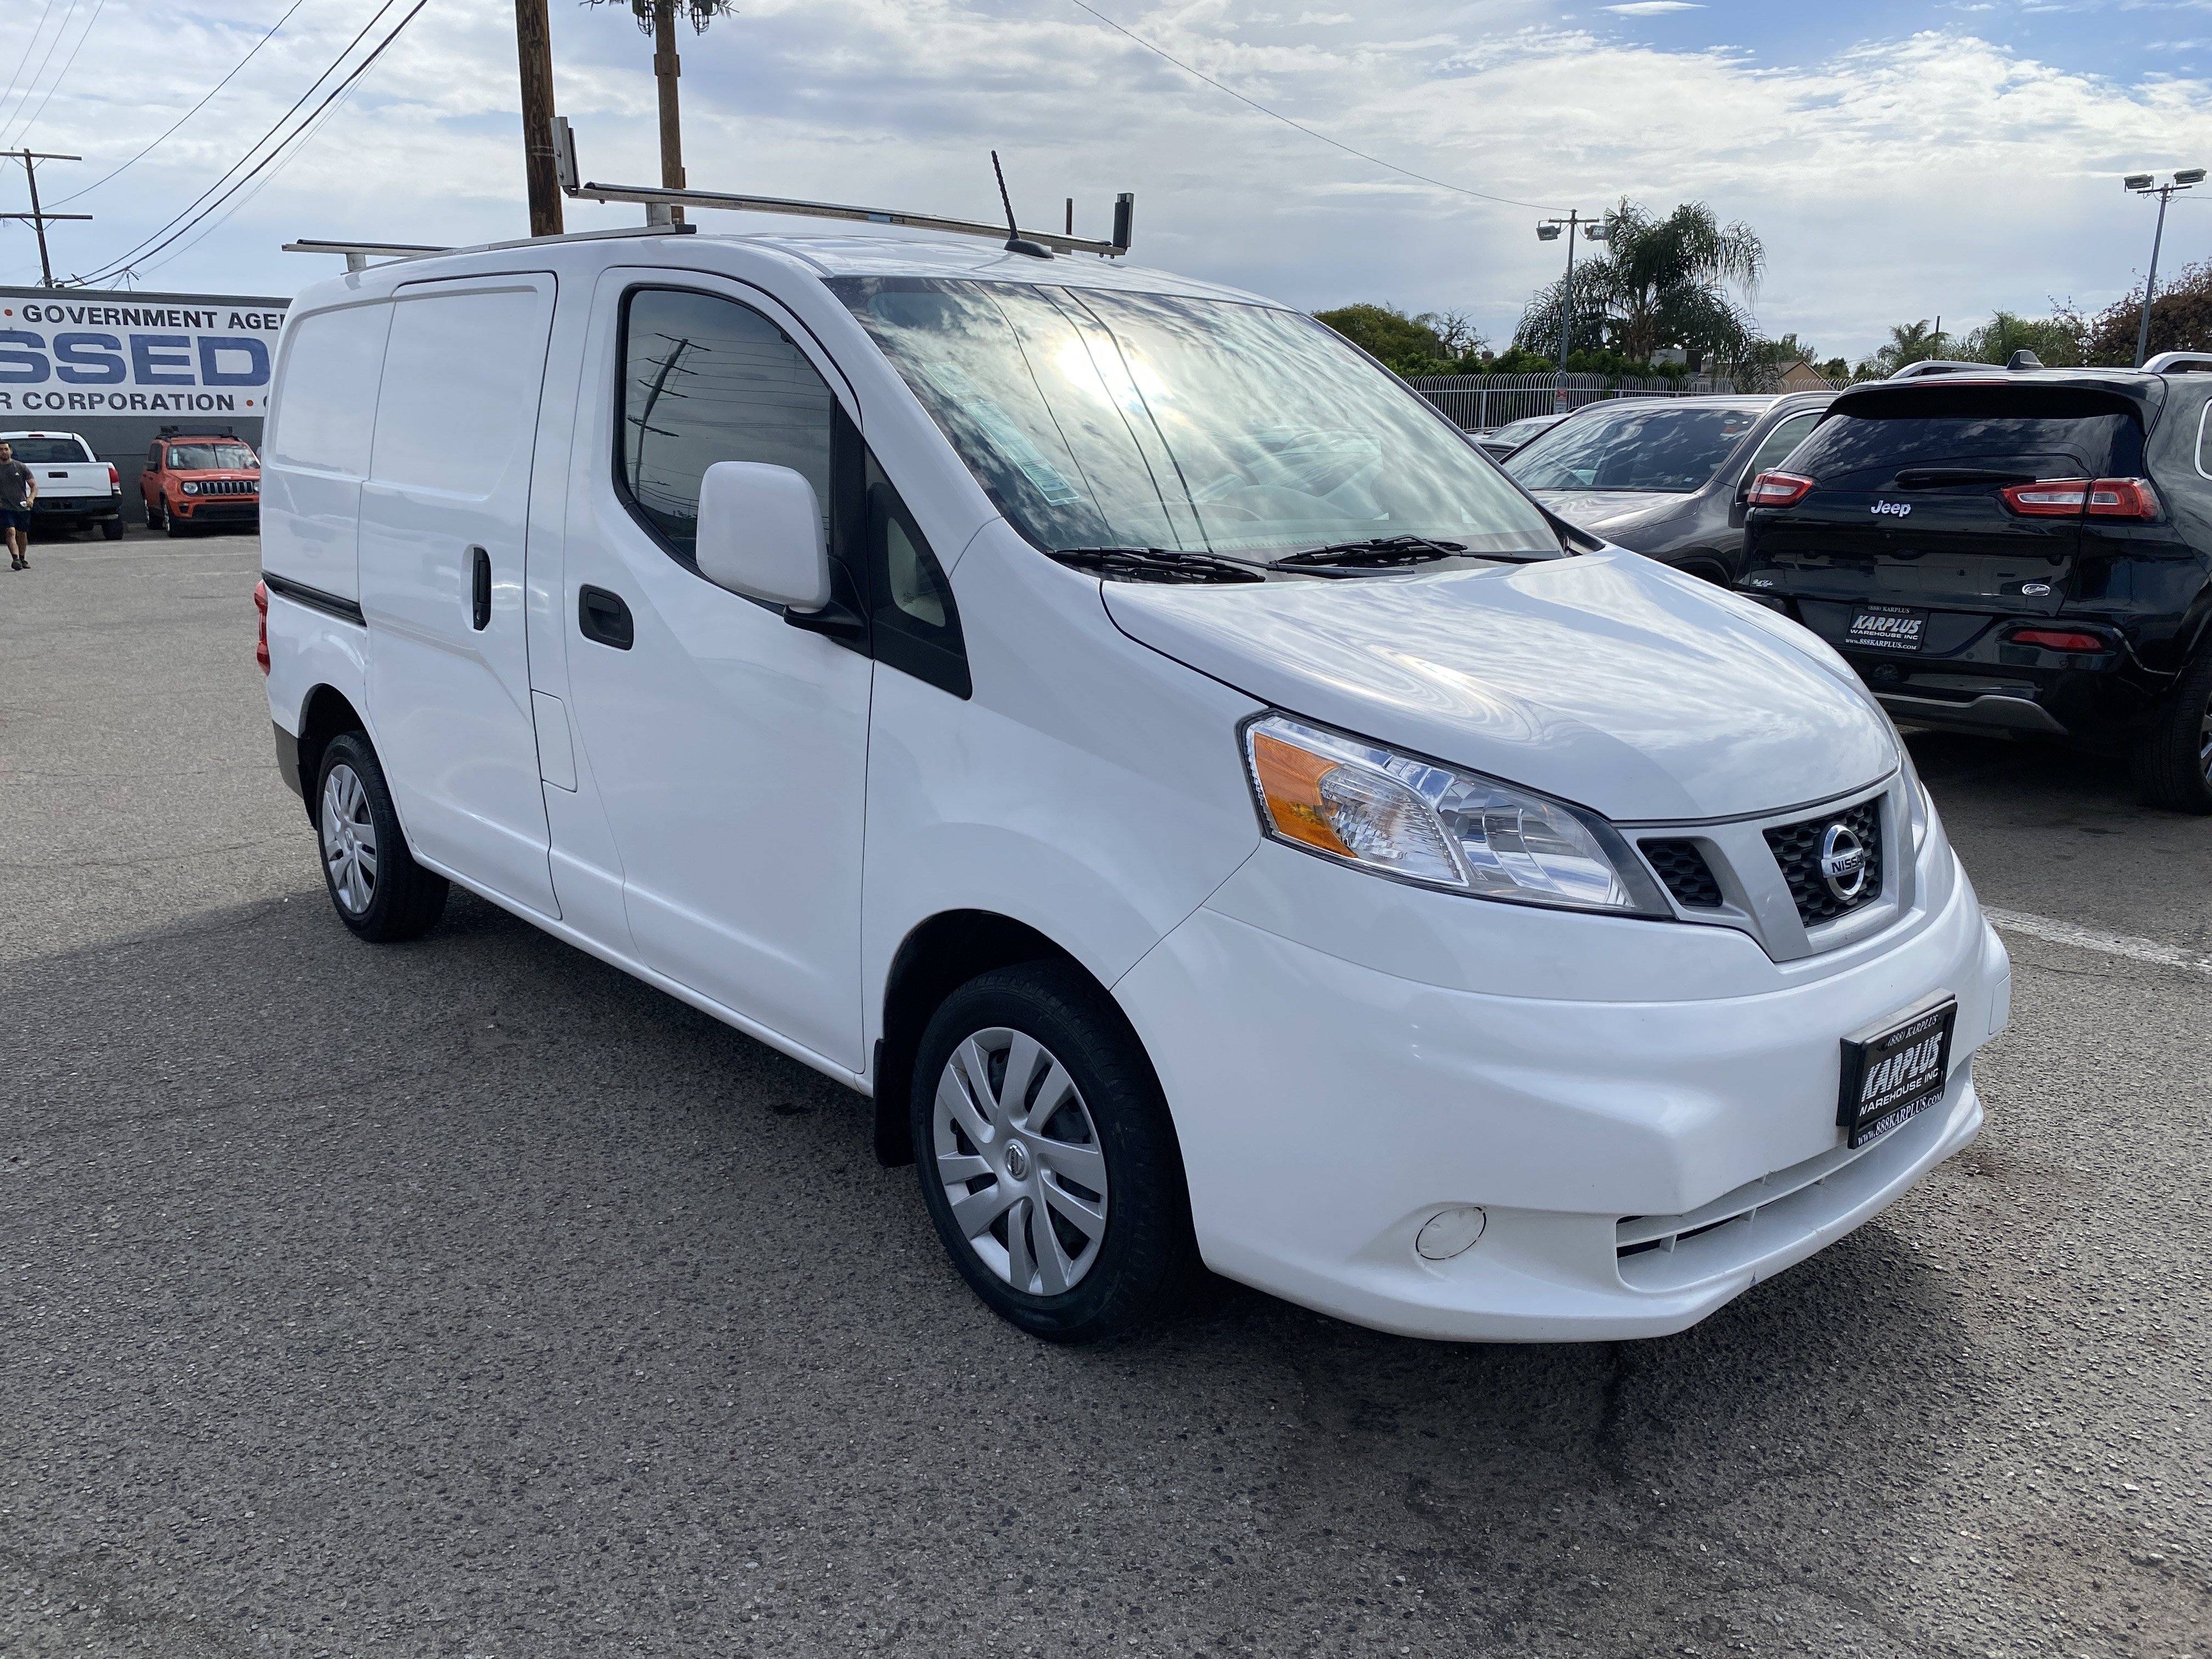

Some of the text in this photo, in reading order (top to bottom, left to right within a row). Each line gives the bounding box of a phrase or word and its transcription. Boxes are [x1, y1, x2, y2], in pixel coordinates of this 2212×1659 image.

[22, 304, 218, 329] GOVERNMENT
[0, 330, 270, 386] SSED
[22, 392, 234, 410] CORPORATION
[1871, 500, 1911, 517] Jeep
[1850, 629, 1901, 638] WAREHOUSE
[1852, 615, 1922, 634] KARPLUS
[1887, 1014, 1939, 1046] (888) KARPLUS
[1861, 1031, 1943, 1102] KARPLUS
[1859, 1068, 1939, 1116] WAREHOUSE INC
